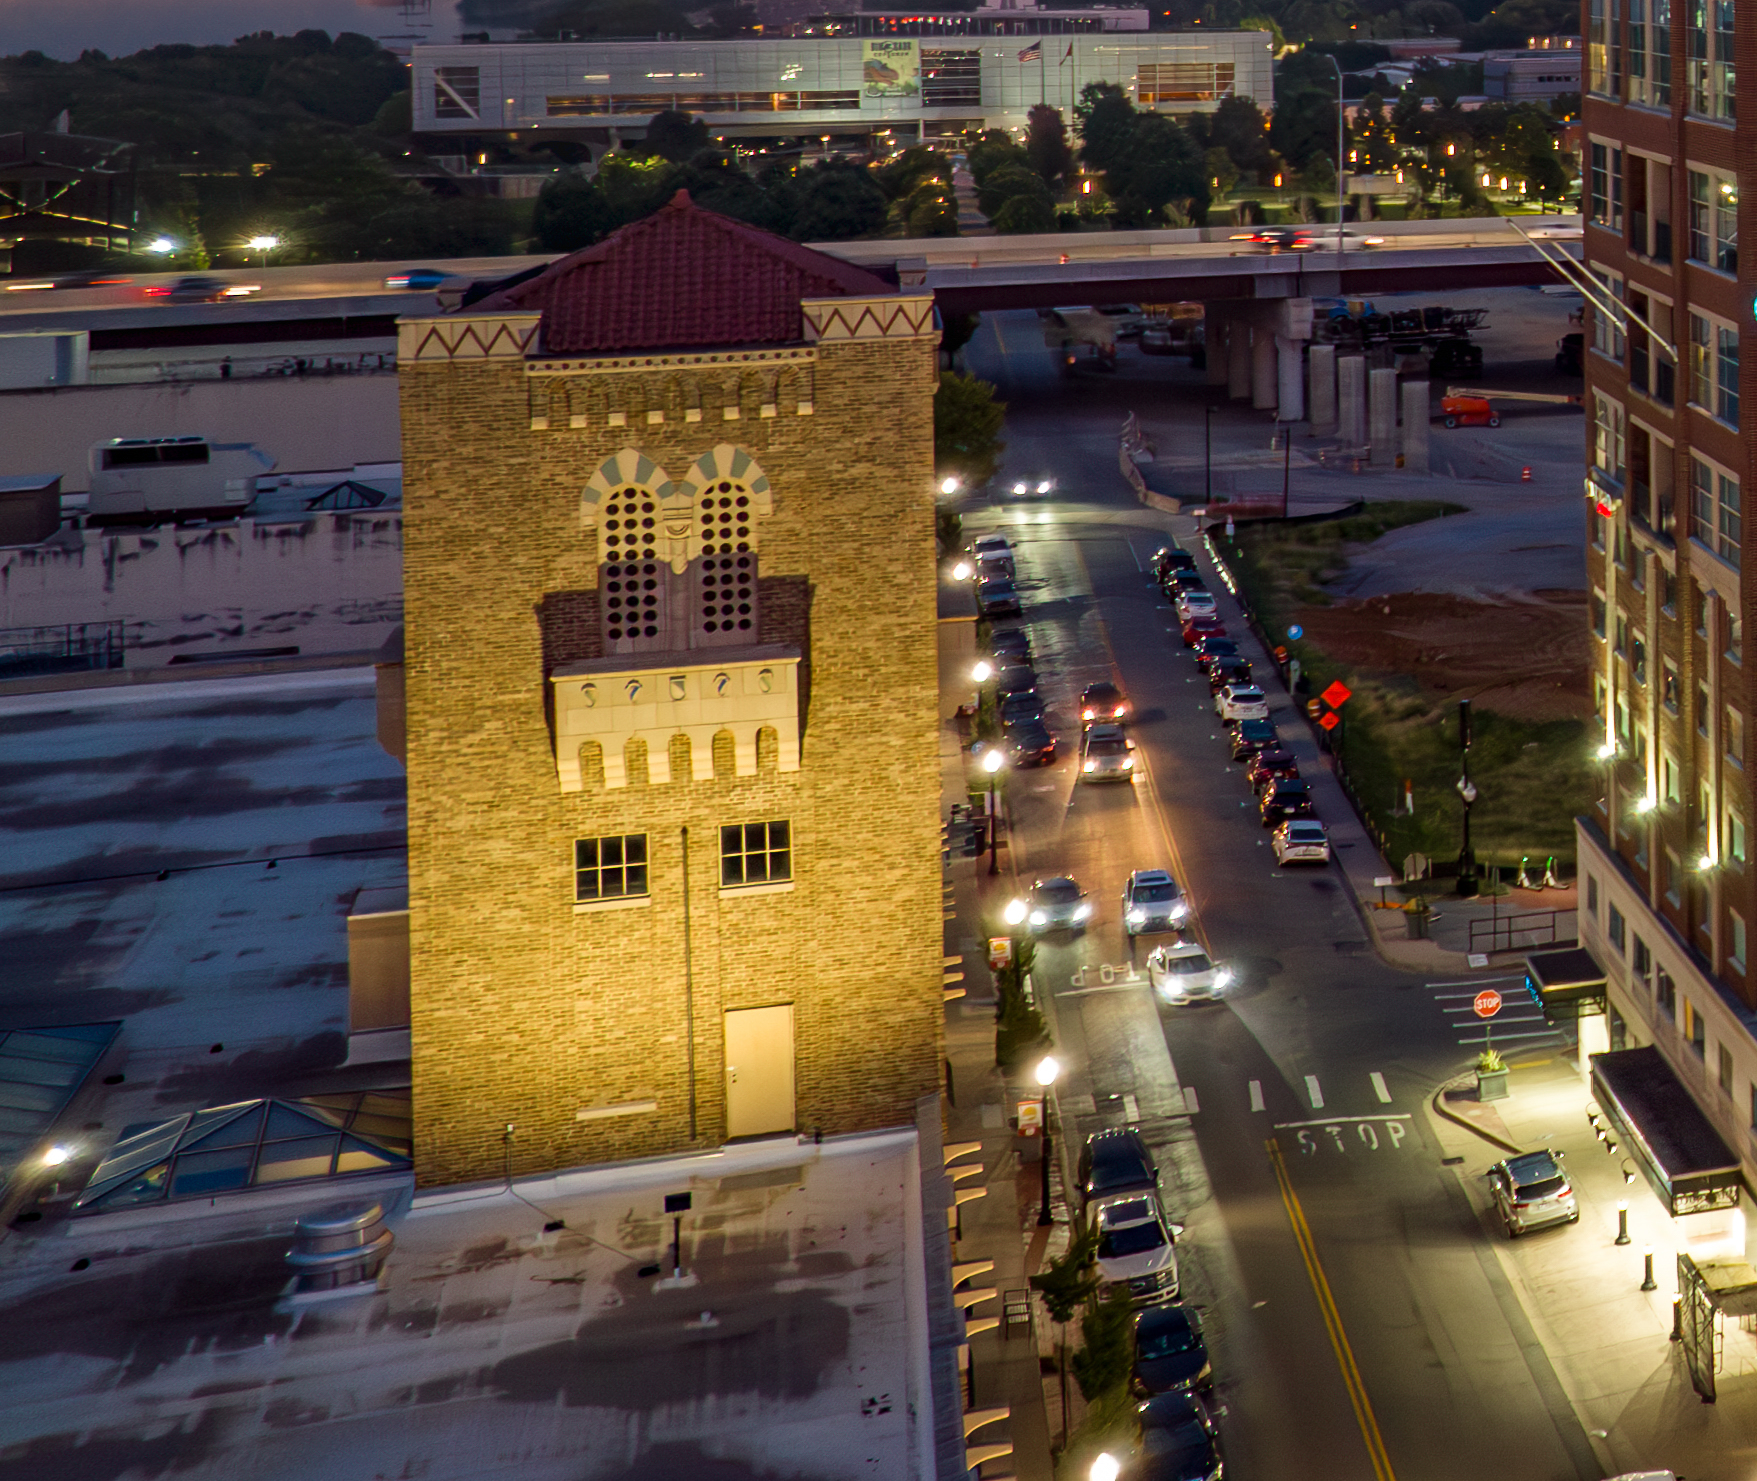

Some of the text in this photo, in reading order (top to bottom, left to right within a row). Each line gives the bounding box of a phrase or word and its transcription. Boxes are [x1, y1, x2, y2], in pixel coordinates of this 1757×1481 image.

[1070, 961, 1141, 986] TOP
[1476, 997, 1500, 1010] STOP
[1297, 1121, 1406, 1156] STOP
